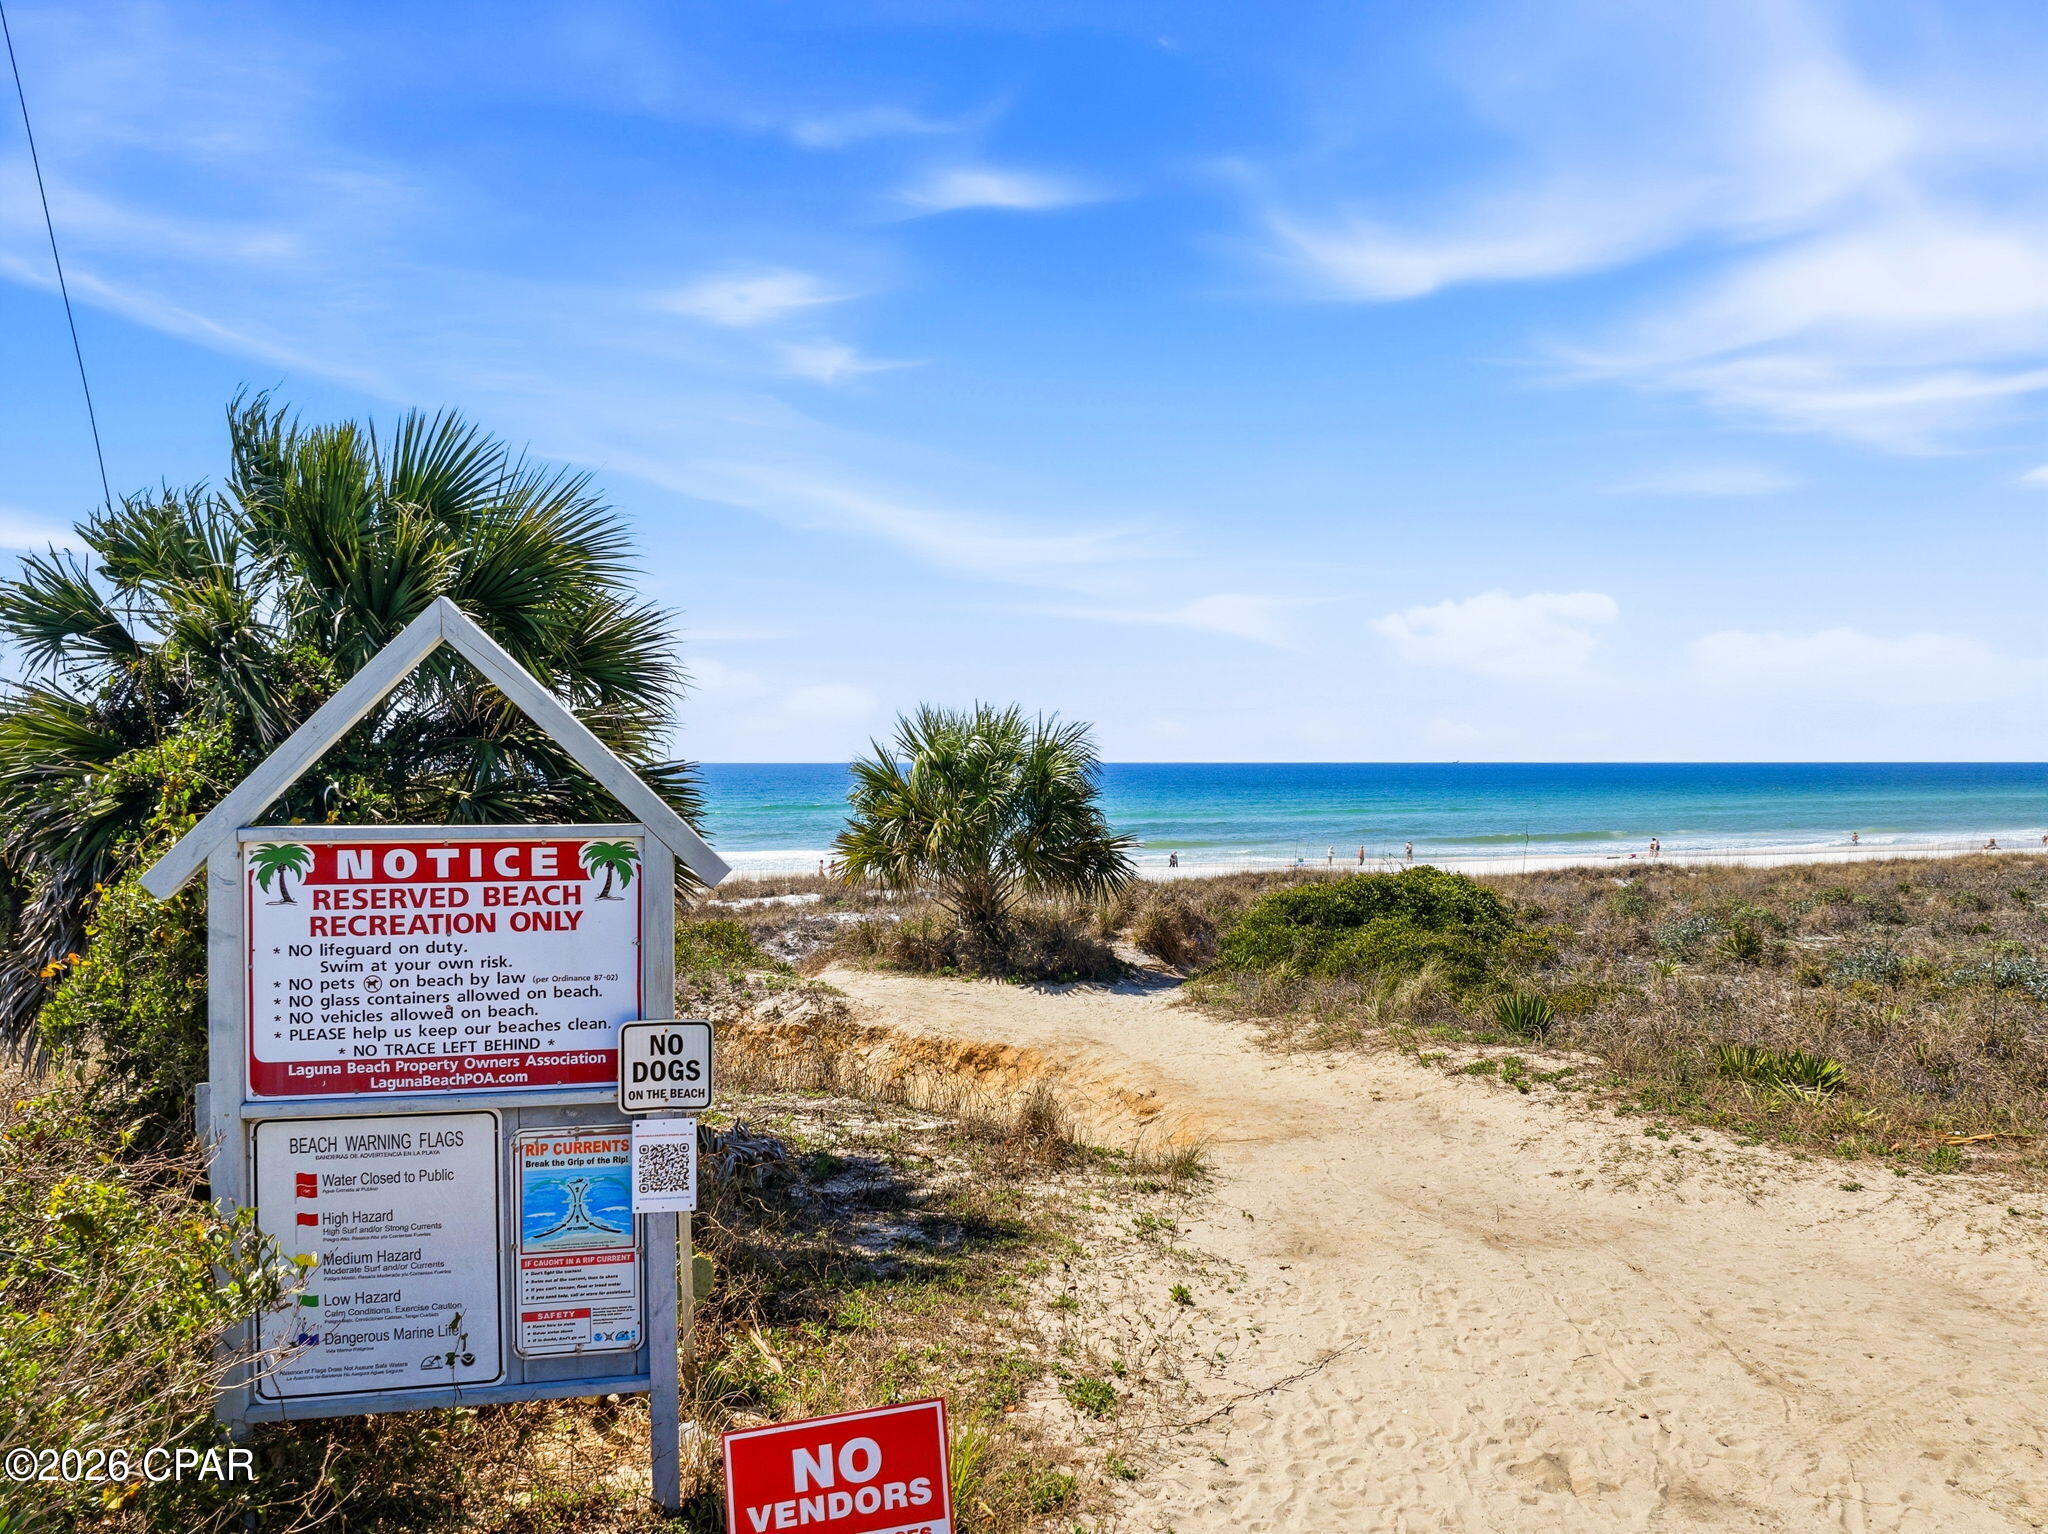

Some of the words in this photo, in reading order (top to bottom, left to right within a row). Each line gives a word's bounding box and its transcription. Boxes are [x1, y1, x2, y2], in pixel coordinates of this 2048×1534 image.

[337, 847, 560, 880] NOTICE
[313, 887, 469, 911] RESERVED
[484, 885, 581, 906] BEACH
[310, 913, 496, 937] RECREATION
[510, 910, 584, 931] ONLY
[289, 945, 312, 956] NO
[320, 942, 392, 959] lifeguard
[399, 944, 419, 954] on
[426, 941, 468, 956] duty.
[320, 960, 363, 972] Swim
[371, 960, 387, 972] at
[395, 960, 430, 974] your
[438, 959, 473, 970] own
[481, 956, 512, 968] risk.
[289, 978, 313, 990] NO
[320, 978, 355, 993] pets
[390, 978, 409, 988] on
[417, 974, 463, 988] beach
[471, 973, 489, 988] by
[497, 972, 526, 984] law
[533, 976, 549, 984] (per
[594, 974, 618, 982] 87-02)
[289, 995, 313, 1007] NO
[320, 994, 359, 1010] glass
[368, 992, 449, 1005] containers
[457, 988, 520, 1002] allowed
[527, 989, 546, 999] on
[554, 985, 602, 998] beach.
[290, 1012, 313, 1024] NO
[321, 1010, 382, 1023] vehicles
[390, 1007, 453, 1021] allowed
[461, 1009, 481, 1018] on
[488, 1004, 538, 1017] beach.
[290, 1028, 346, 1041] PLEASE
[353, 1026, 386, 1041] help
[395, 1027, 411, 1038] us
[419, 1025, 457, 1039] keep
[465, 1024, 491, 1035] our
[499, 1020, 560, 1033] beaches
[568, 1018, 611, 1030] clean.
[354, 1045, 377, 1057] NO
[384, 1043, 435, 1055] TRACE
[443, 1041, 477, 1054] LEFT
[484, 1038, 540, 1052] BEHIND
[650, 1034, 683, 1056] NO
[288, 1064, 342, 1078] Laguna
[348, 1060, 390, 1075] Beach
[395, 1058, 458, 1076] Property
[464, 1055, 520, 1069] Owners
[526, 1052, 606, 1065] Association
[633, 1060, 700, 1083] DOGS
[370, 1071, 528, 1089] LagunaBeachPOA.com
[628, 1091, 643, 1100] ON
[646, 1089, 666, 1099] THE
[670, 1088, 705, 1098] BEACH
[290, 1137, 337, 1154] BEACH
[345, 1133, 411, 1151] WARNING
[419, 1131, 464, 1148] FLAGS
[525, 1143, 548, 1157] RIP
[553, 1140, 630, 1154] CURRENTS
[526, 1160, 549, 1168] Break
[568, 1158, 584, 1166] Grip
[597, 1156, 610, 1164] the
[613, 1156, 628, 1164] Rip!
[322, 1174, 357, 1187] Water
[361, 1171, 400, 1185] Closed
[404, 1171, 415, 1182] to
[419, 1169, 454, 1182] Public
[323, 1212, 348, 1227] High
[353, 1210, 393, 1223] Hazard
[384, 1224, 409, 1232] Strong
[411, 1222, 442, 1230] Currents
[323, 1252, 372, 1266] Medium
[377, 1248, 422, 1262] Hazard
[533, 1259, 564, 1267] CAUGHT
[324, 1267, 362, 1275] Moderate
[364, 1265, 380, 1273] Surf
[383, 1263, 408, 1271] and/or
[411, 1261, 445, 1269] Currents
[324, 1294, 351, 1307] Low
[355, 1289, 400, 1304] Hazard
[325, 1310, 345, 1318] Calm
[395, 1305, 430, 1313] Exercise
[431, 1302, 462, 1310] Caution
[537, 1311, 575, 1320] SAFETY
[325, 1331, 390, 1346] Dangerous
[394, 1327, 434, 1340] Marine
[438, 1325, 459, 1337] Life
[792, 1437, 882, 1494] NO
[747, 1477, 932, 1533] VENDORS
